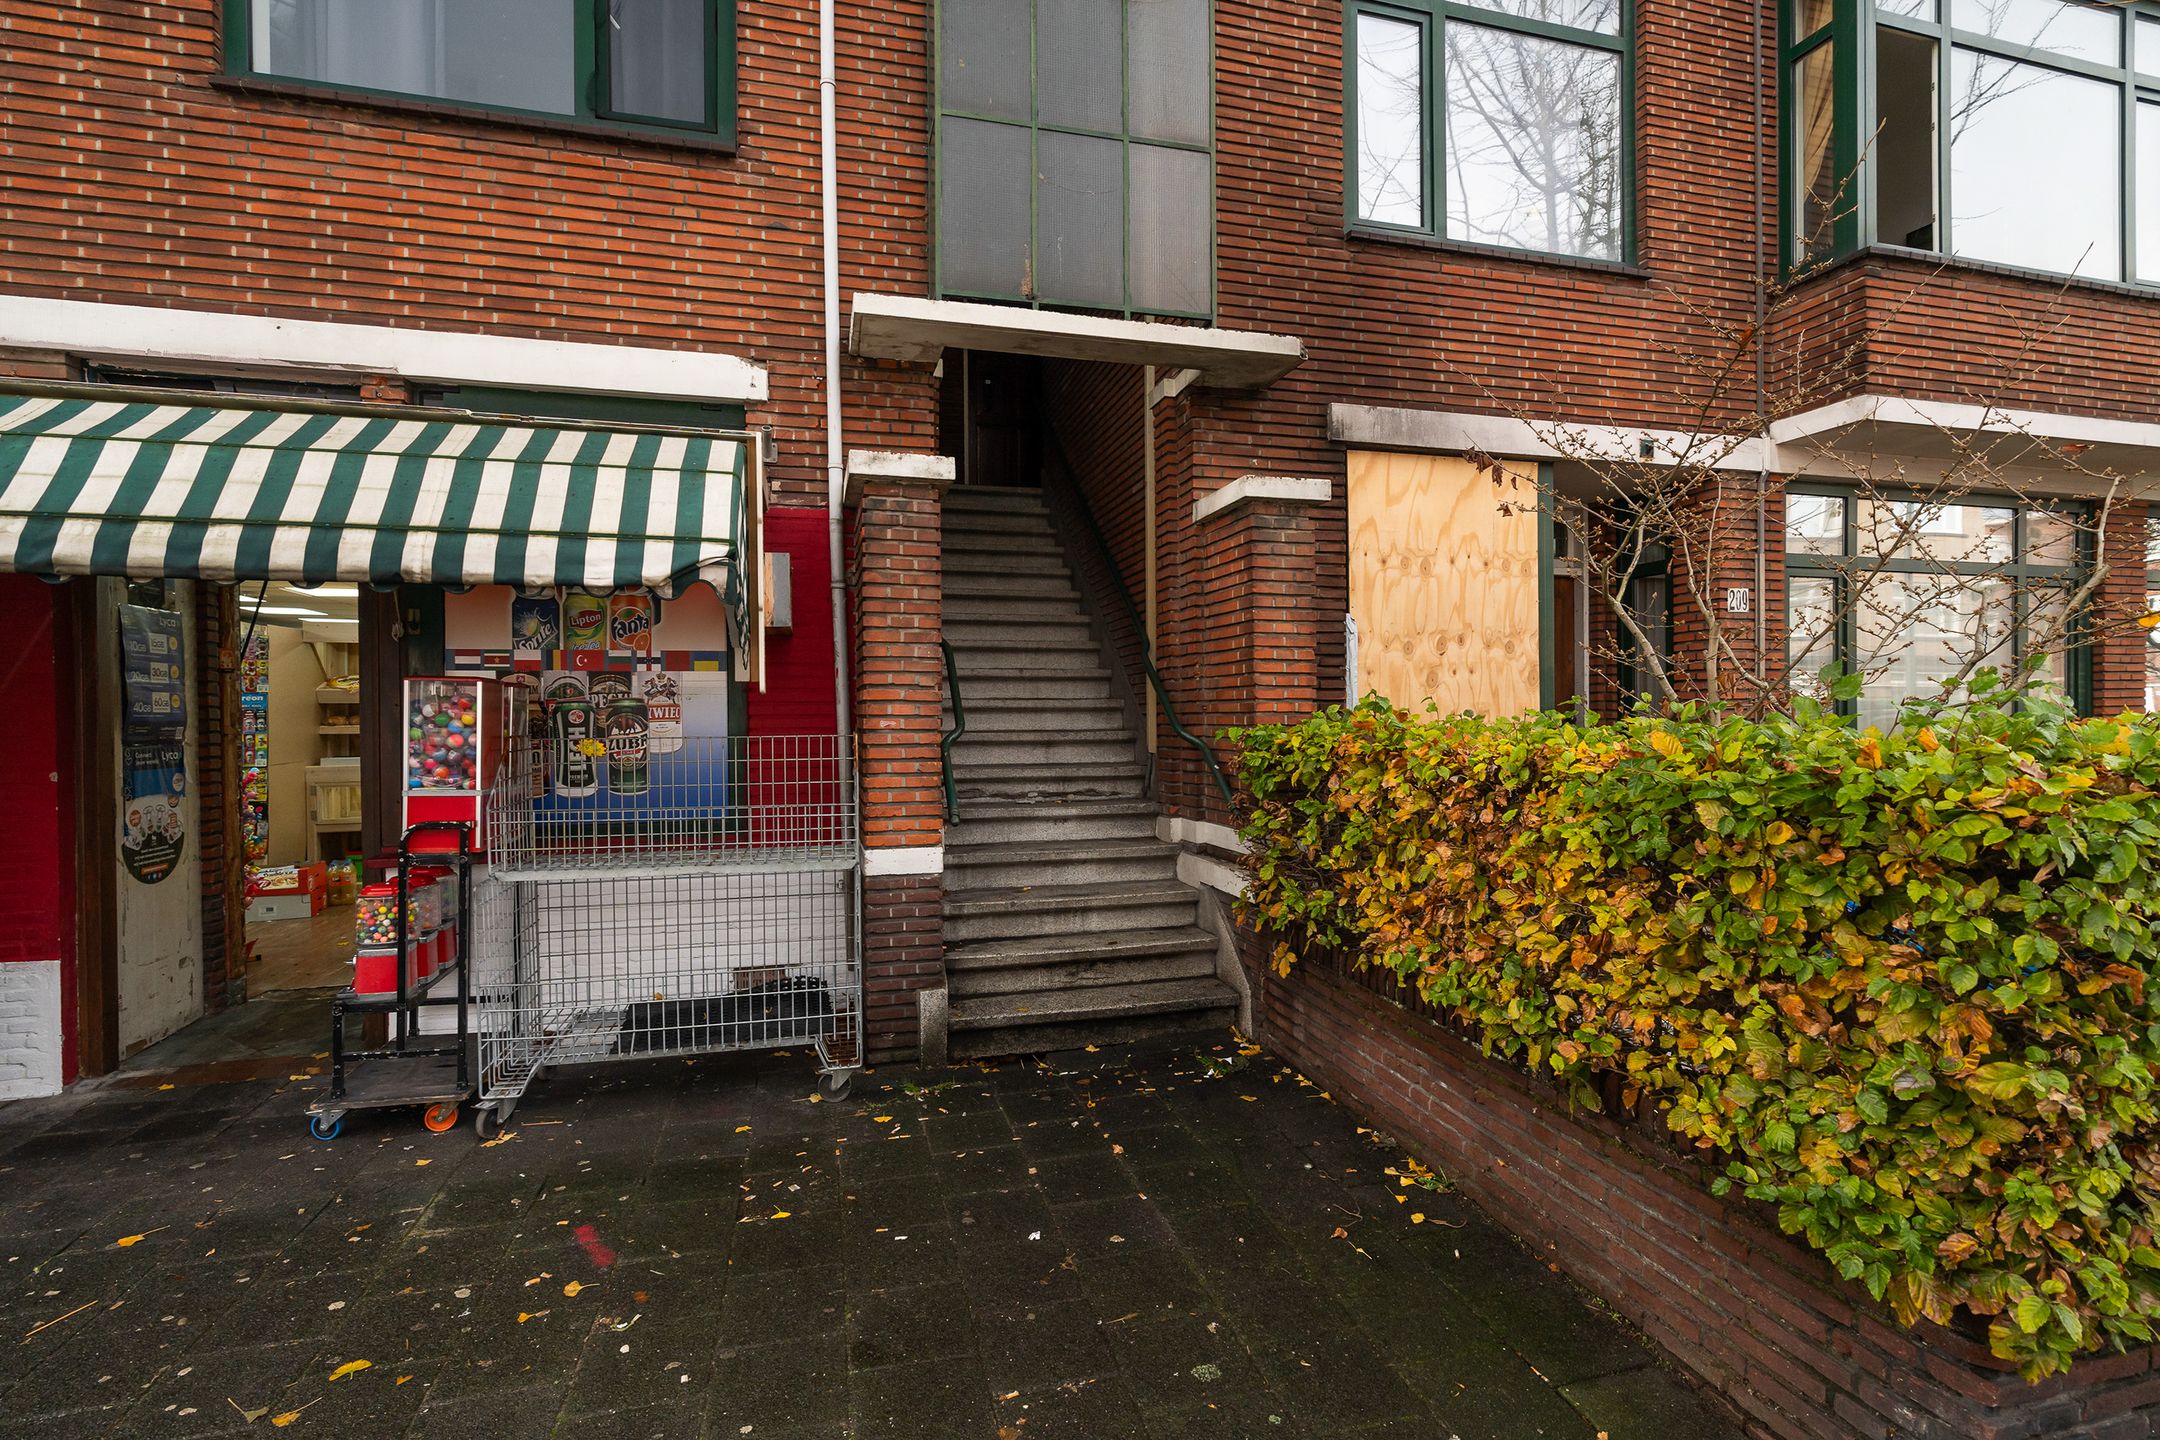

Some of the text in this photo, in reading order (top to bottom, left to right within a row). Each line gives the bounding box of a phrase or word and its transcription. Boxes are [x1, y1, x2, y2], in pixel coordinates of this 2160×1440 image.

[1728, 589, 1748, 610] 209
[570, 614, 601, 626] Lipton
[612, 613, 649, 641] Fanta
[241, 694, 264, 702] reon
[648, 706, 680, 719] YWIEC
